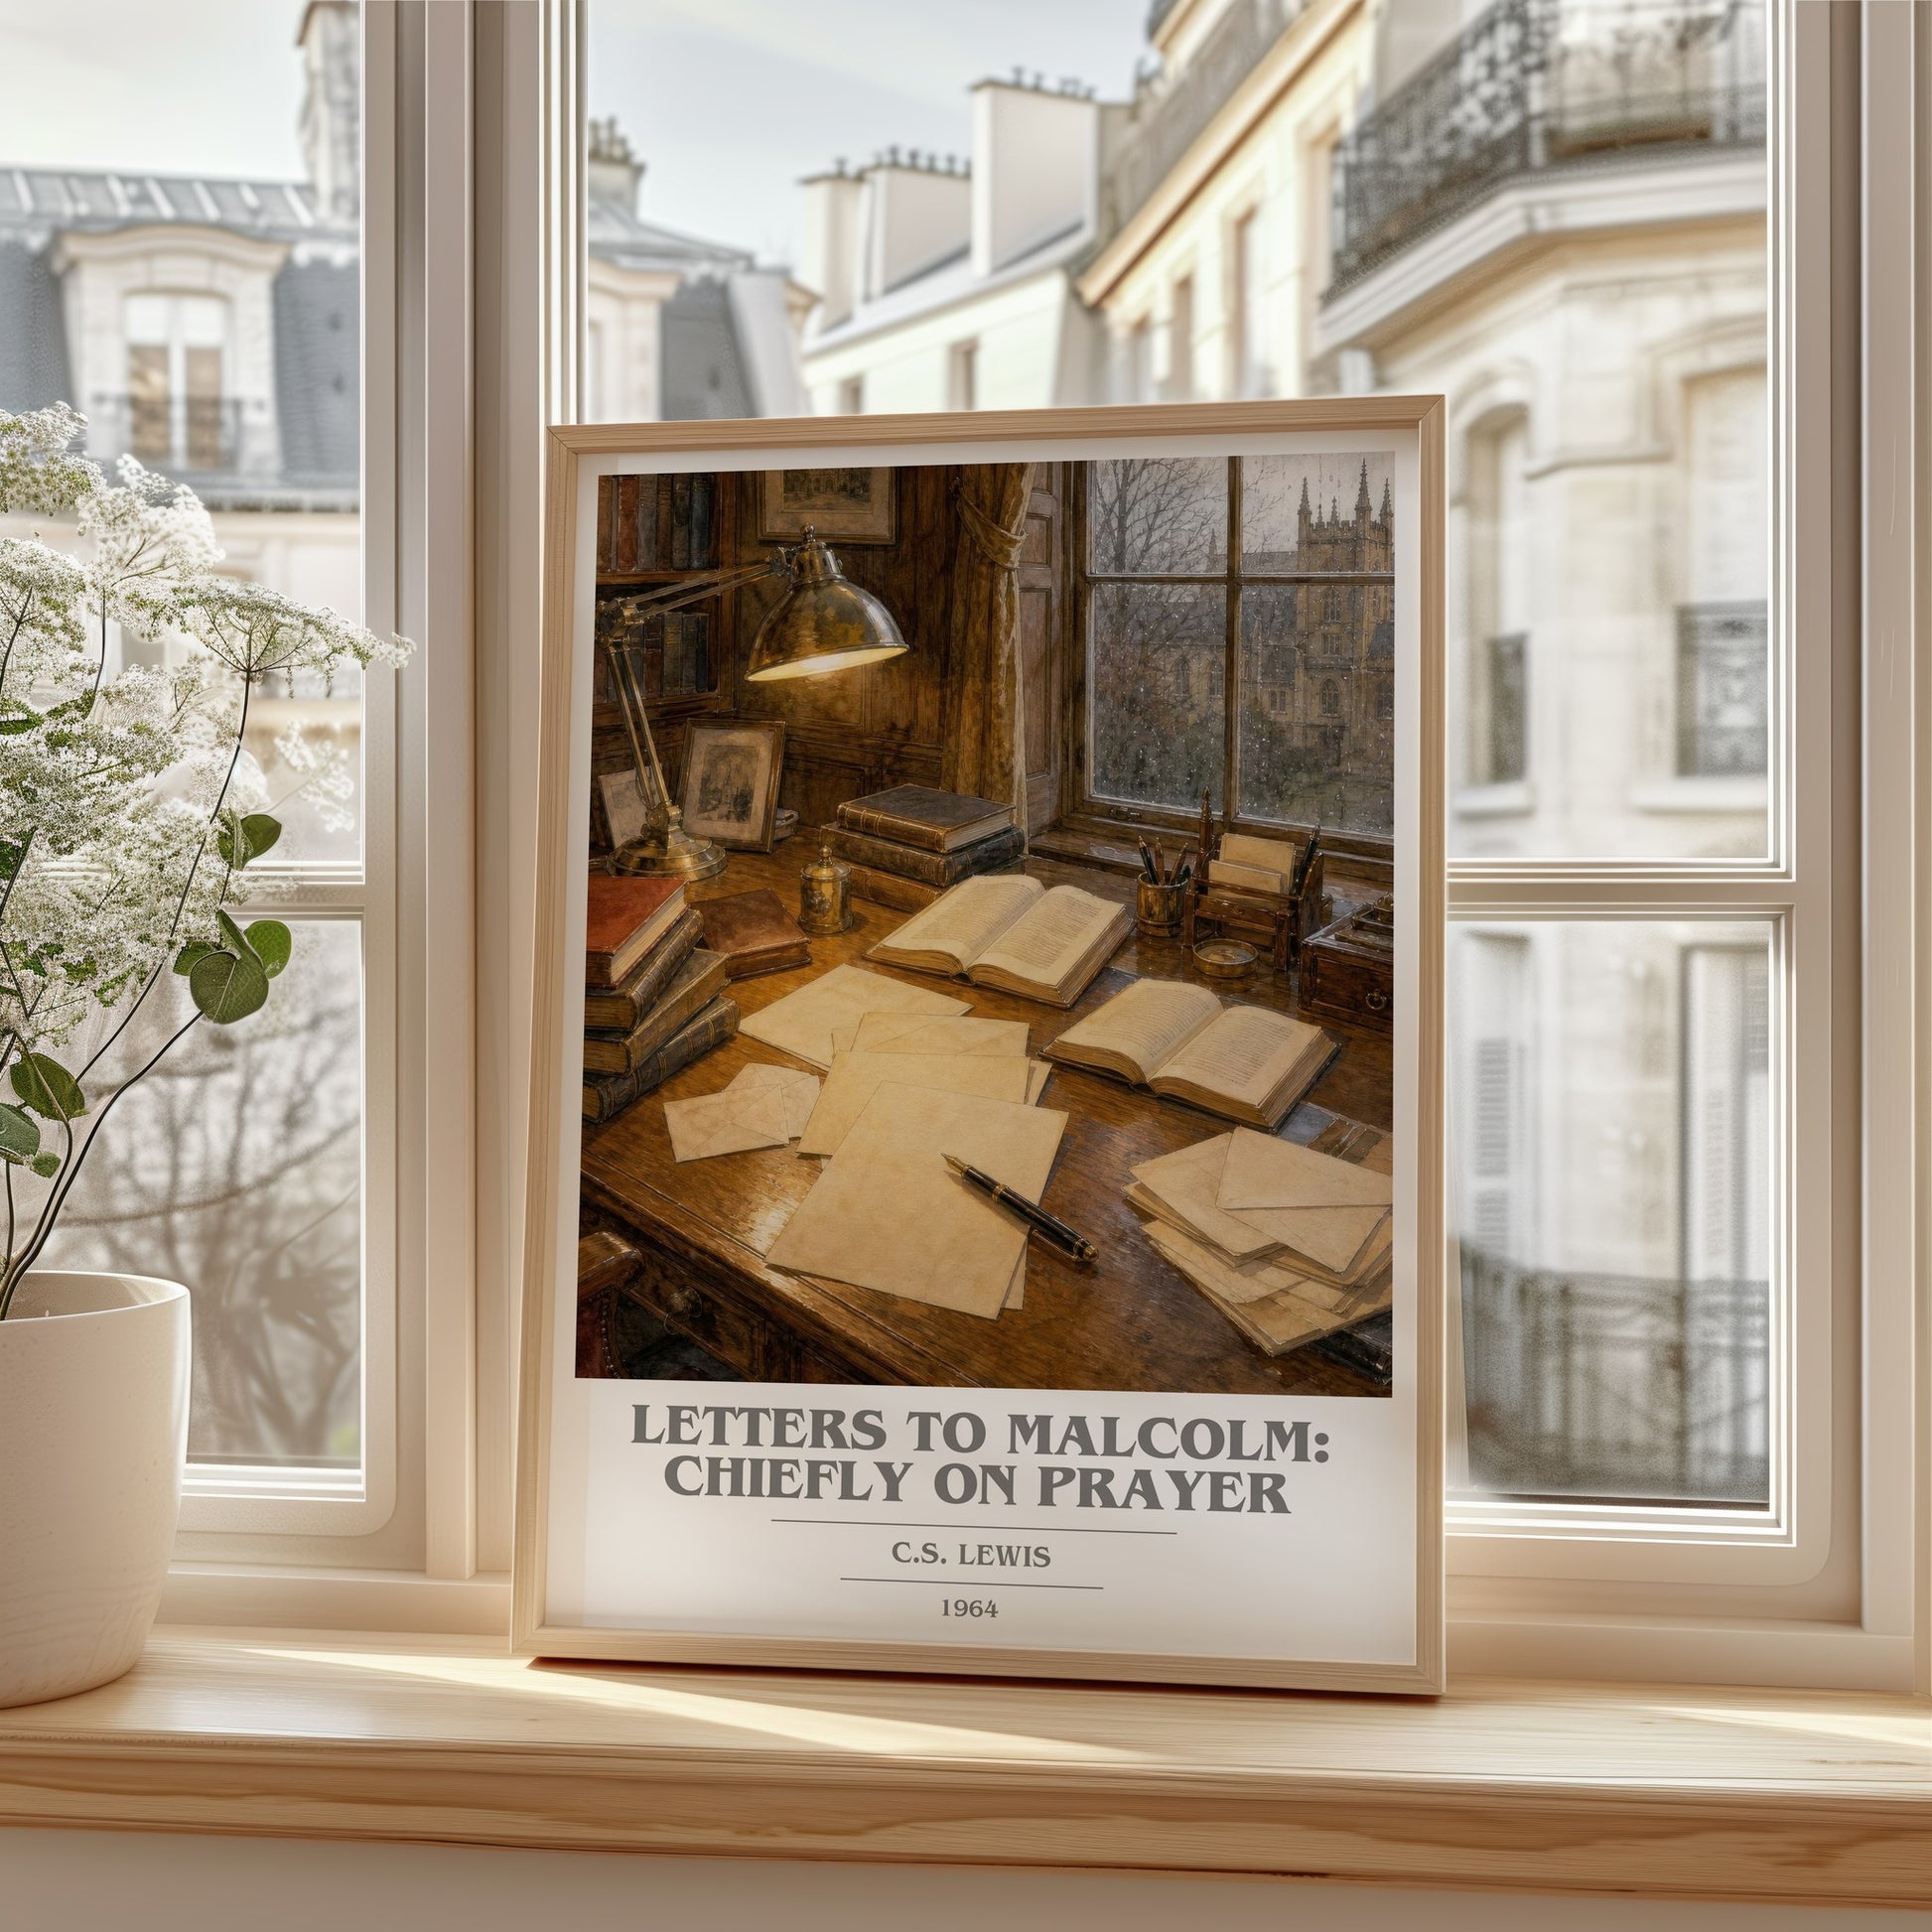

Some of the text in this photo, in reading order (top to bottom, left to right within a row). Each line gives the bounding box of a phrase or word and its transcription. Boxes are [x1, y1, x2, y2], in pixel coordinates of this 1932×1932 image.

[629, 1403, 1329, 1463] LETTERS TO MALCOLM:
[663, 1453, 1293, 1515] CHIEFLY ON PRAYER
[892, 1541, 1051, 1569] C.S. LEWIS
[941, 1598, 1000, 1619] 1964
